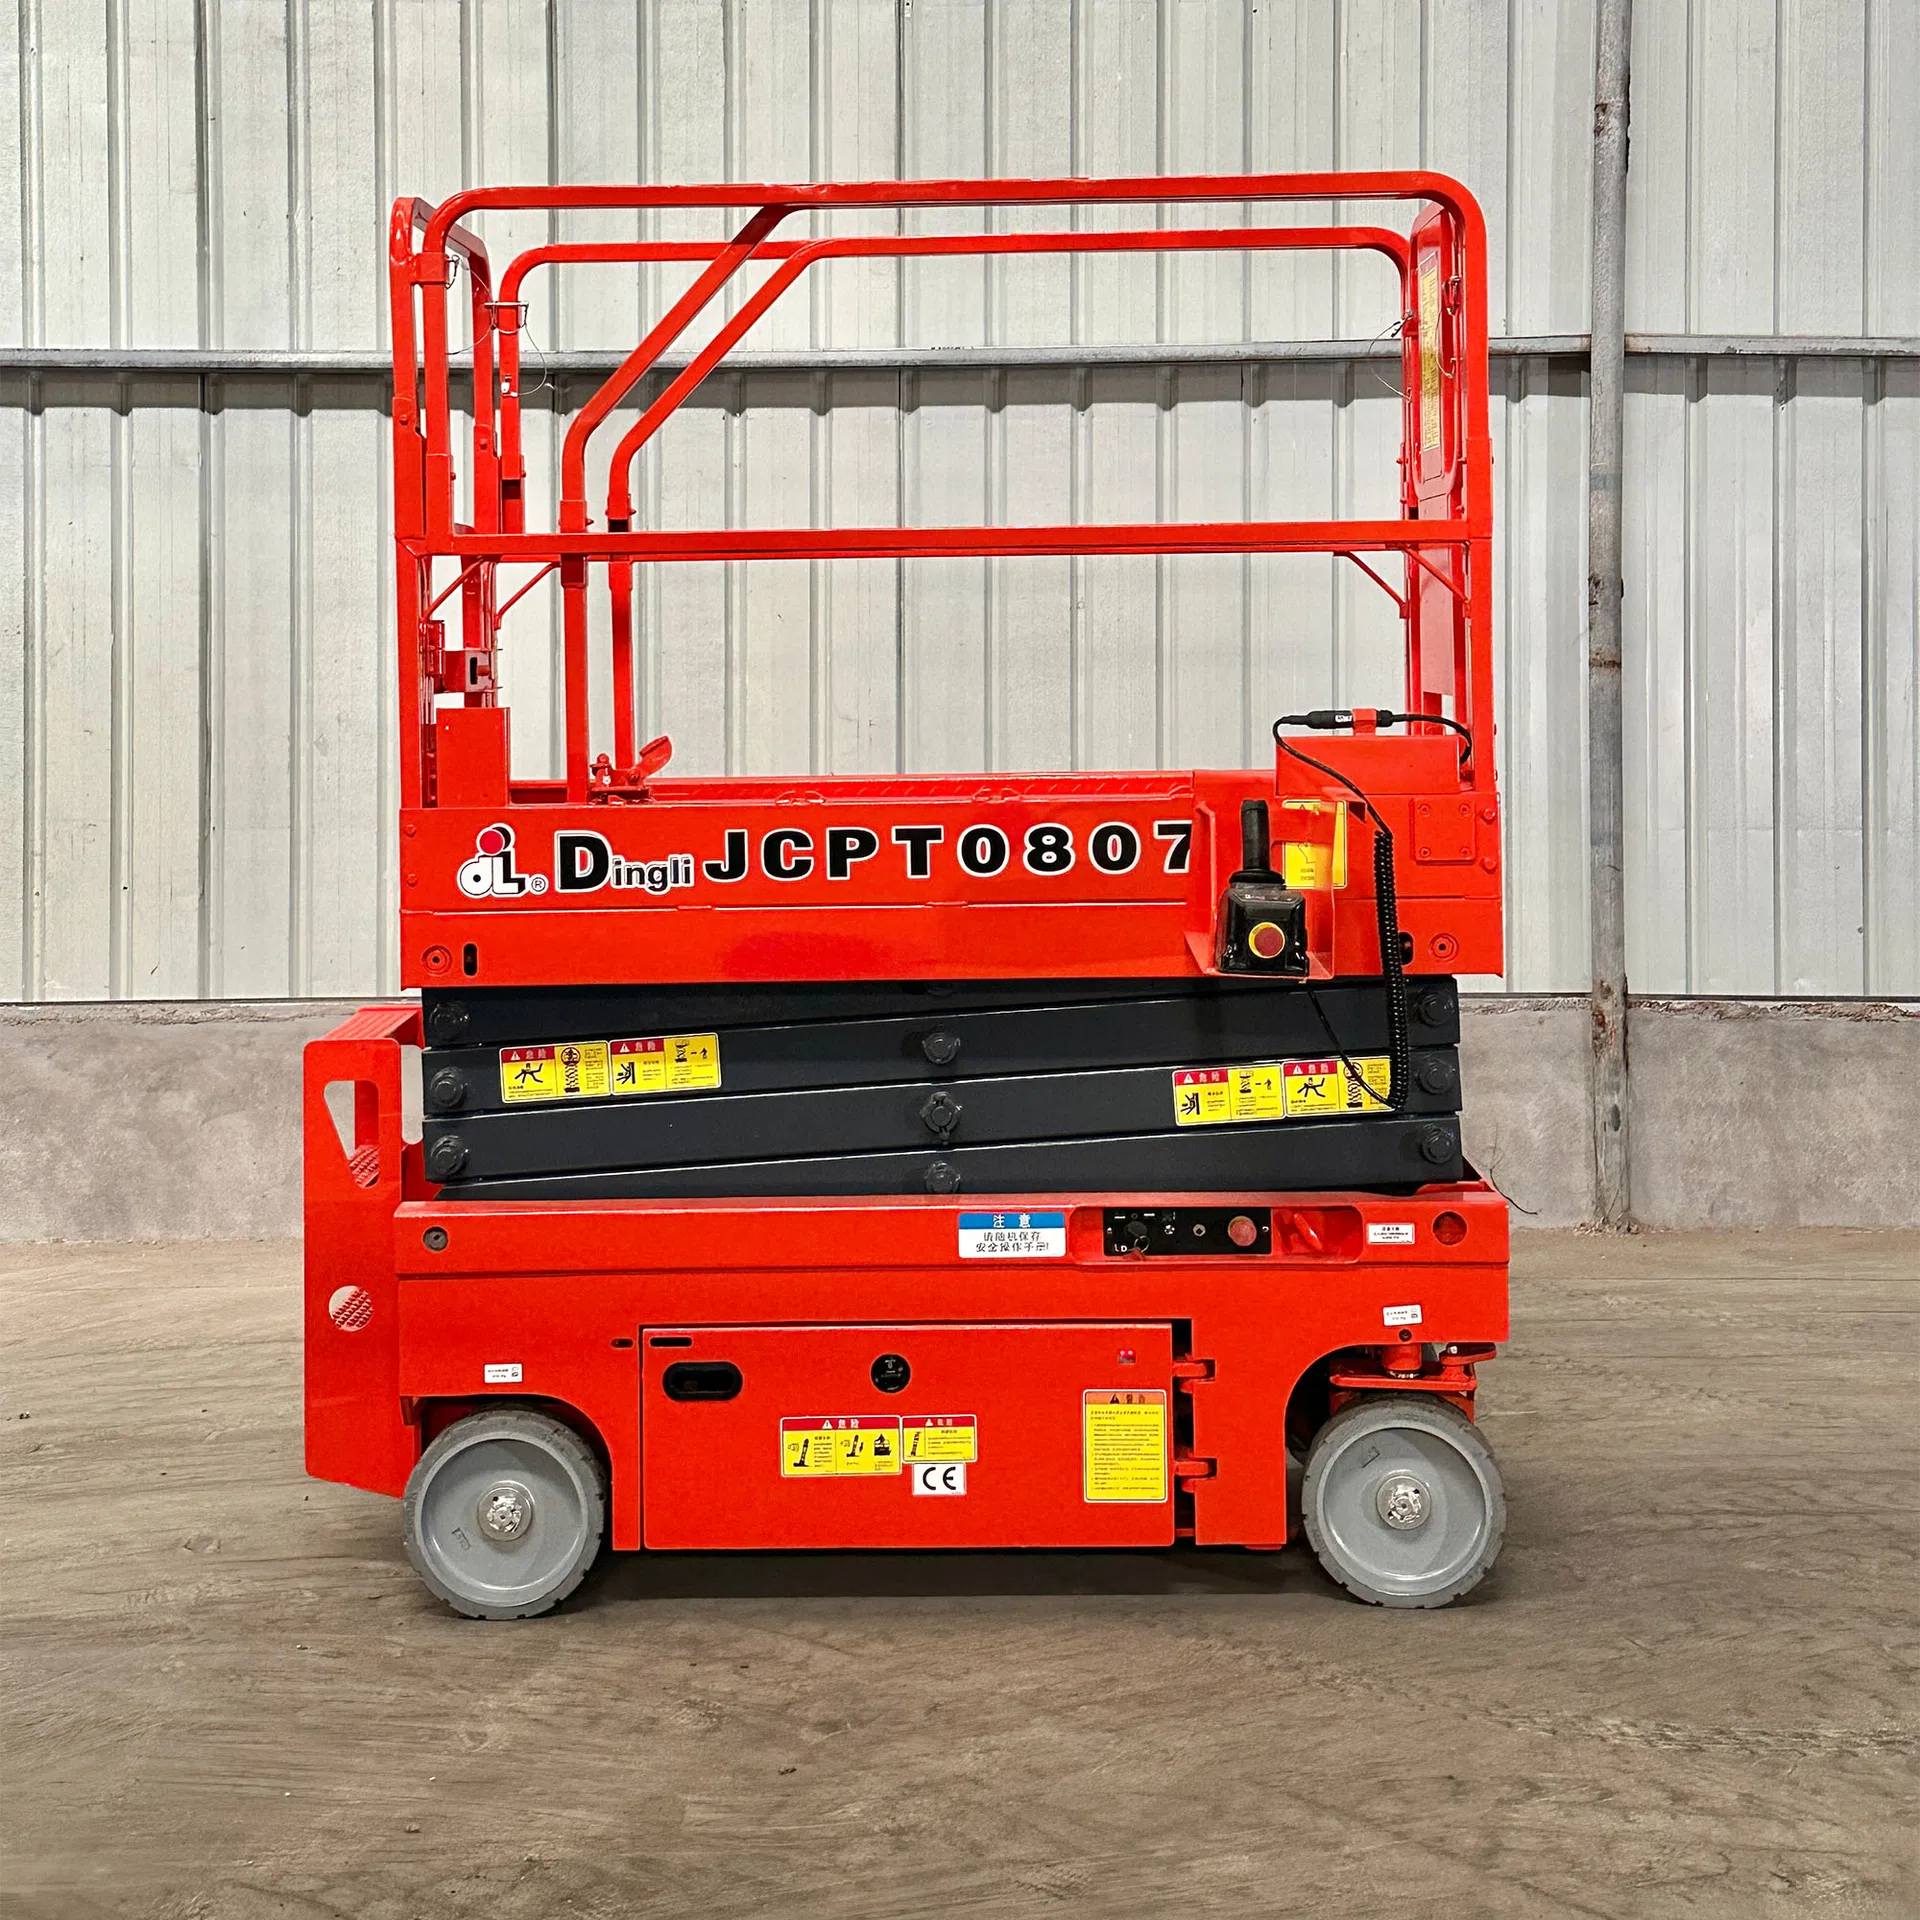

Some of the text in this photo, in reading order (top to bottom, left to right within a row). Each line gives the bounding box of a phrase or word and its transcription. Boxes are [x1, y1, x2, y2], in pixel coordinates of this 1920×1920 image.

[556, 831, 693, 894] Dingli
[703, 821, 1192, 882] JCPT0807
[993, 1213, 1031, 1229] 注意
[922, 1466, 957, 1491] CE
